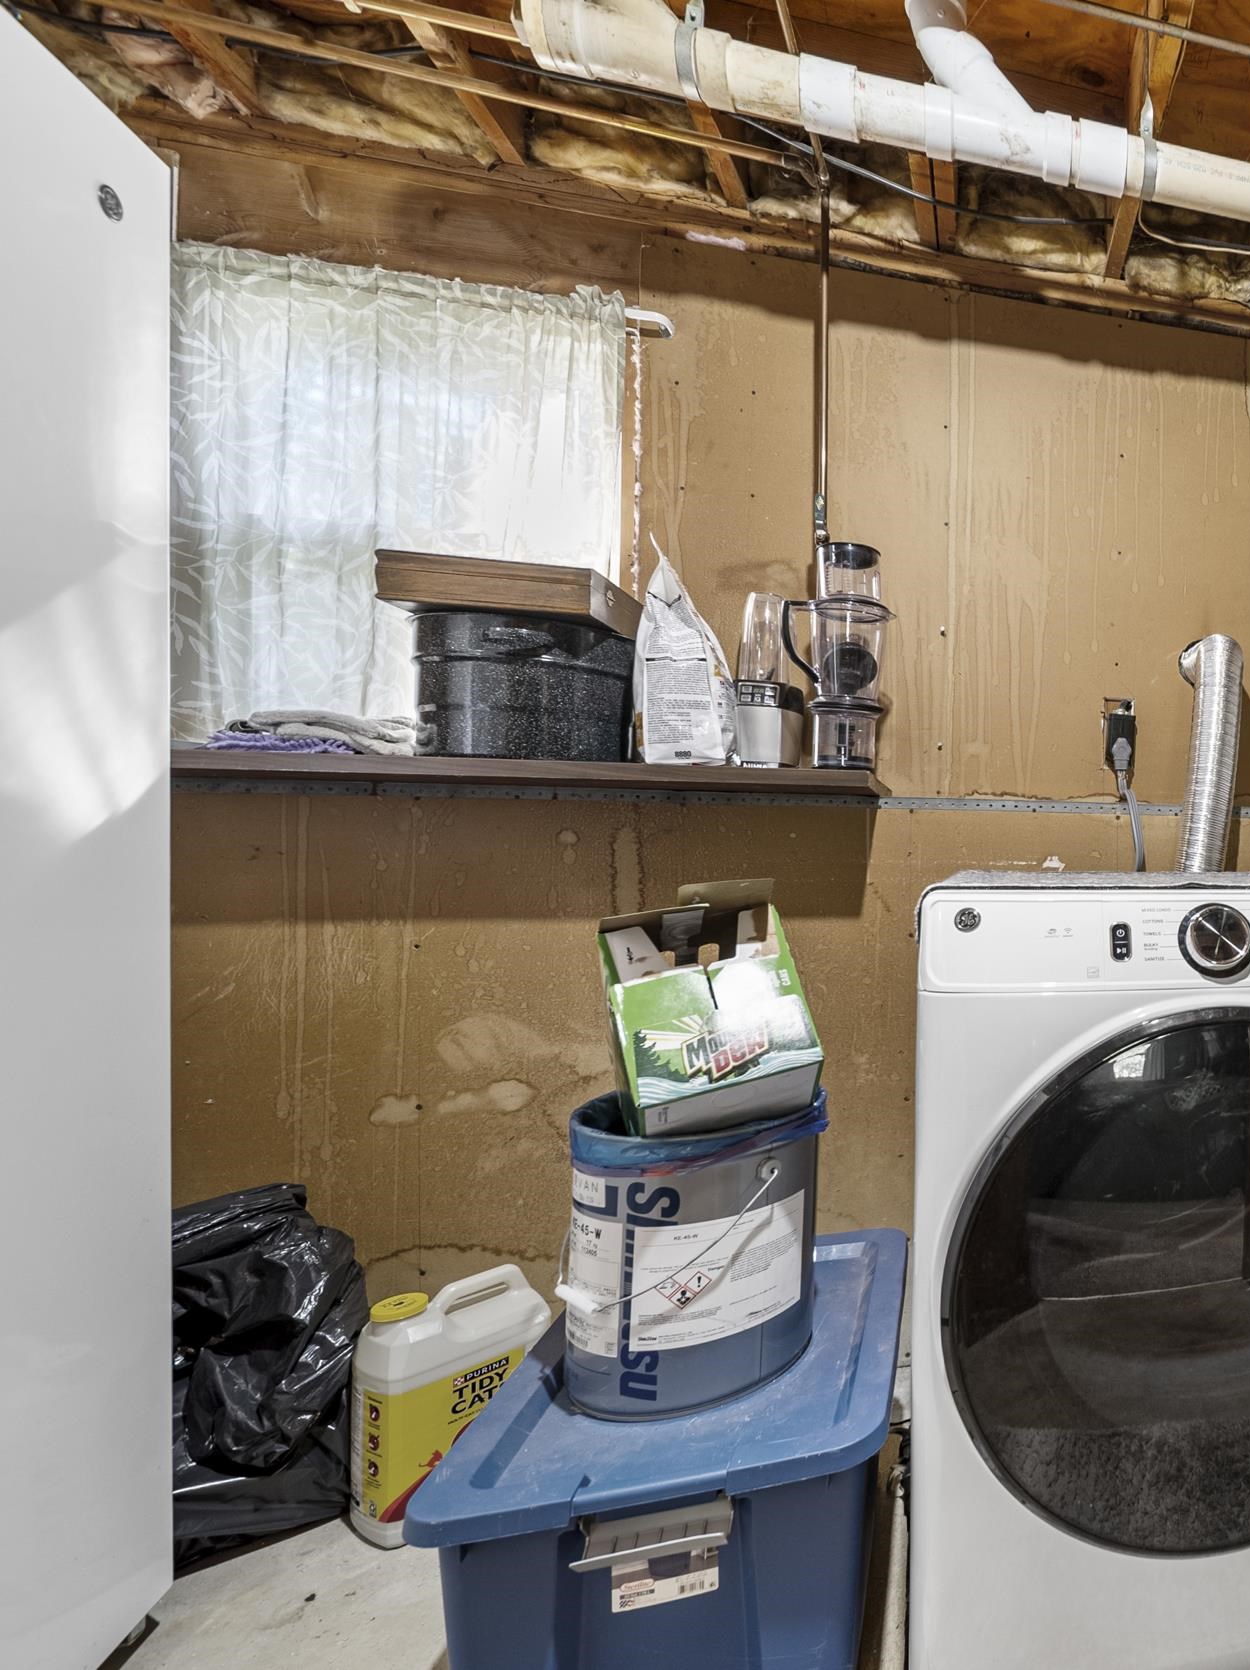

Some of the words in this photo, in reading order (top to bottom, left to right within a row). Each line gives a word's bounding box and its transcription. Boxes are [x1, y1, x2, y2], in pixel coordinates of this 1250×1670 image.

[453, 1367, 508, 1400] TIDY
[466, 1359, 507, 1380] PURINA
[451, 1381, 504, 1415] CAT
